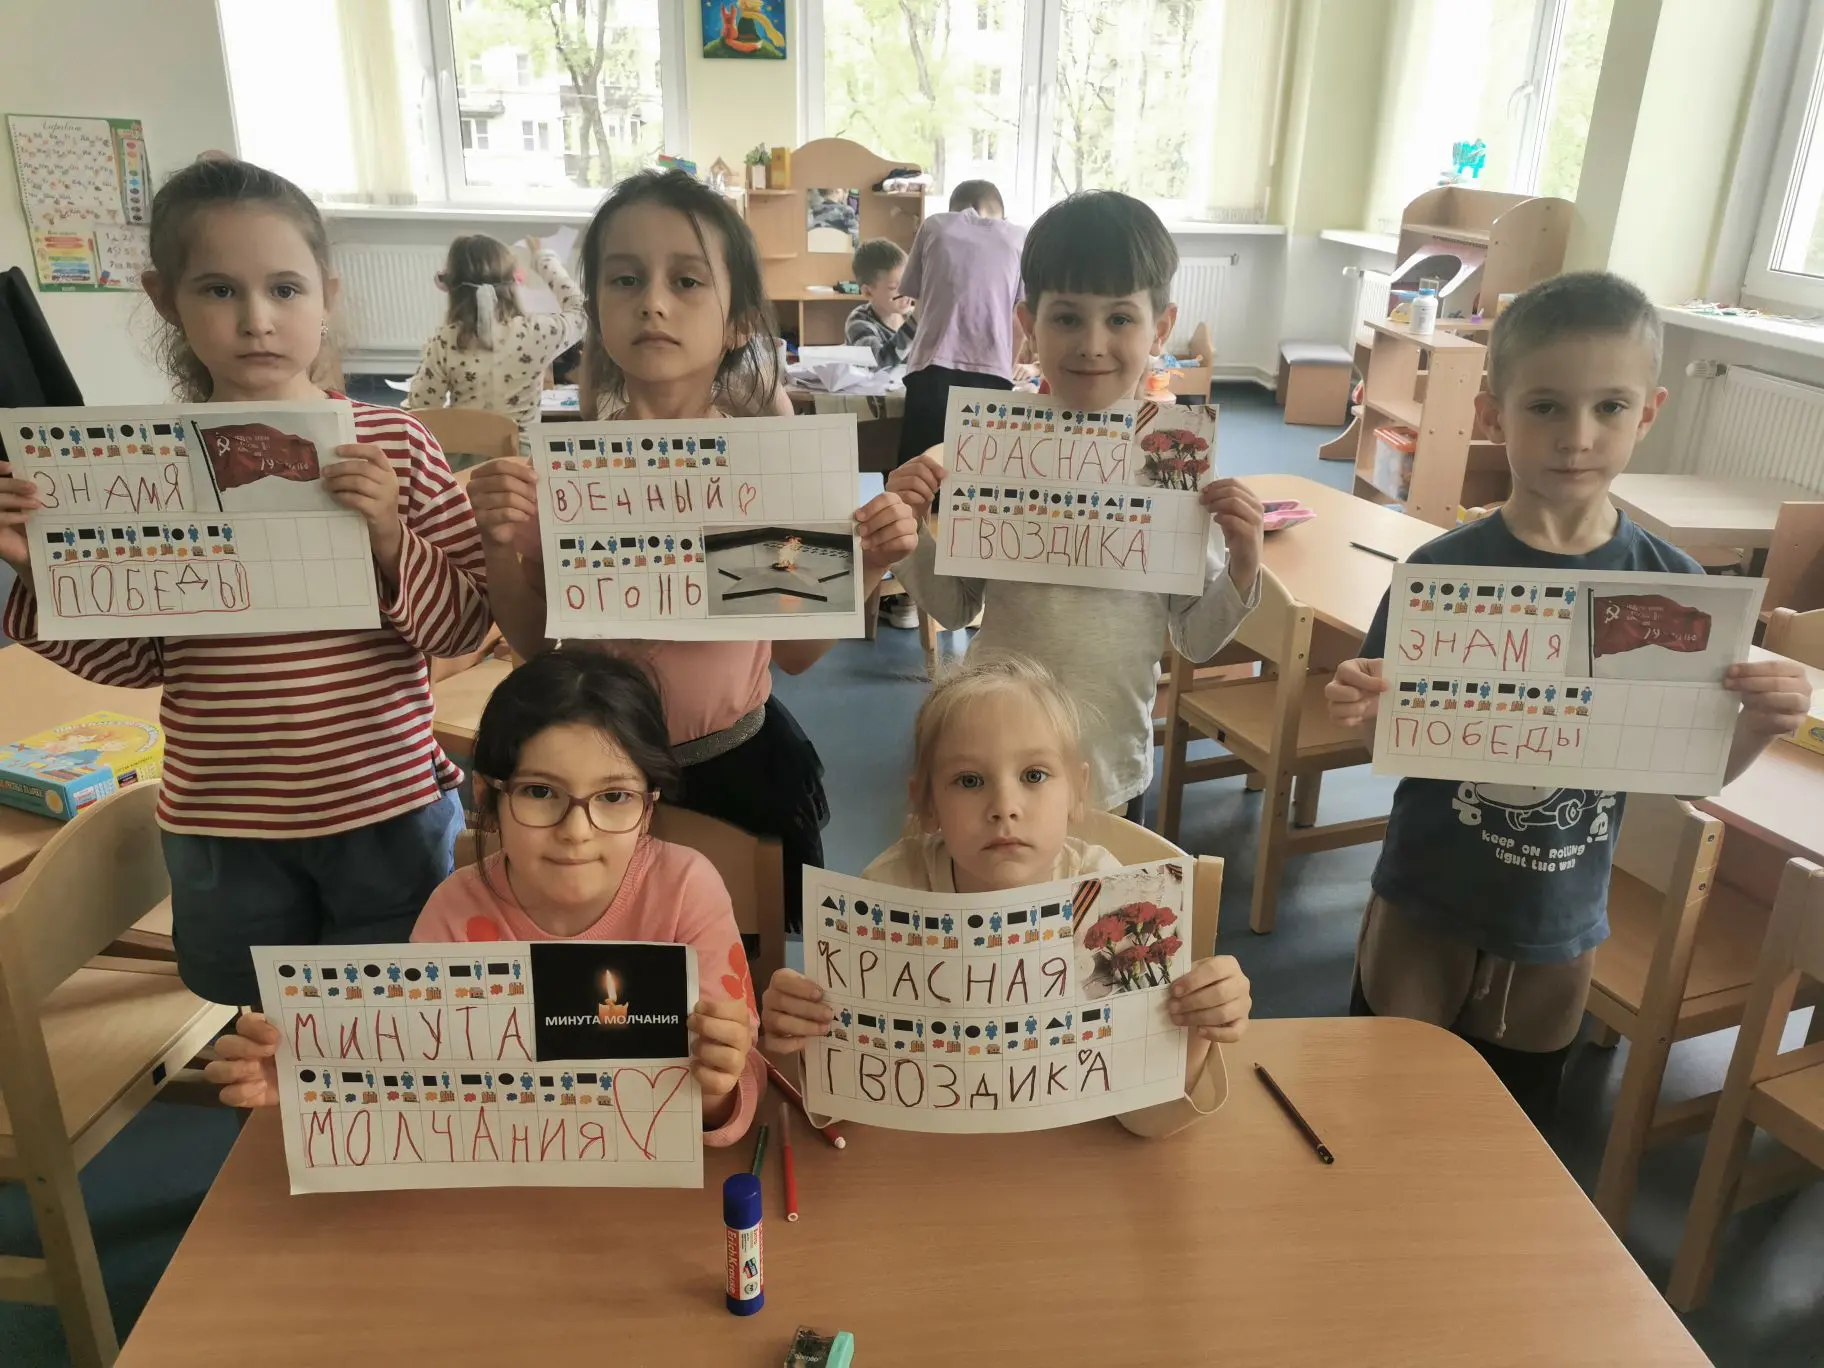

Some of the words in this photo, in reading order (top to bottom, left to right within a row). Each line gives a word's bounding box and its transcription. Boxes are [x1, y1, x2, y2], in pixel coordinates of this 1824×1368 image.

[955, 433, 1129, 484] КРАСНАЯ
[33, 463, 184, 514] ЗНАМЯ
[951, 517, 1148, 574] ГВОЗДИКА
[57, 562, 246, 614] ПОБЕДЫ
[566, 574, 703, 615] ОГОНЬ
[1399, 628, 1561, 672] ЗНАМЯ
[1395, 717, 1581, 761] ПОБЕДЫ
[1481, 829, 1515, 849] keep
[818, 945, 1067, 1004] КРАСНАЯ
[294, 1006, 533, 1061] МИНУТА
[545, 1015, 602, 1027] МИНУТА
[604, 1014, 679, 1025] МОЛЧАНИЯ
[826, 1049, 1111, 1111] ГВОЗДИКА
[307, 1105, 608, 1168] МОЛЧАНИЯ
